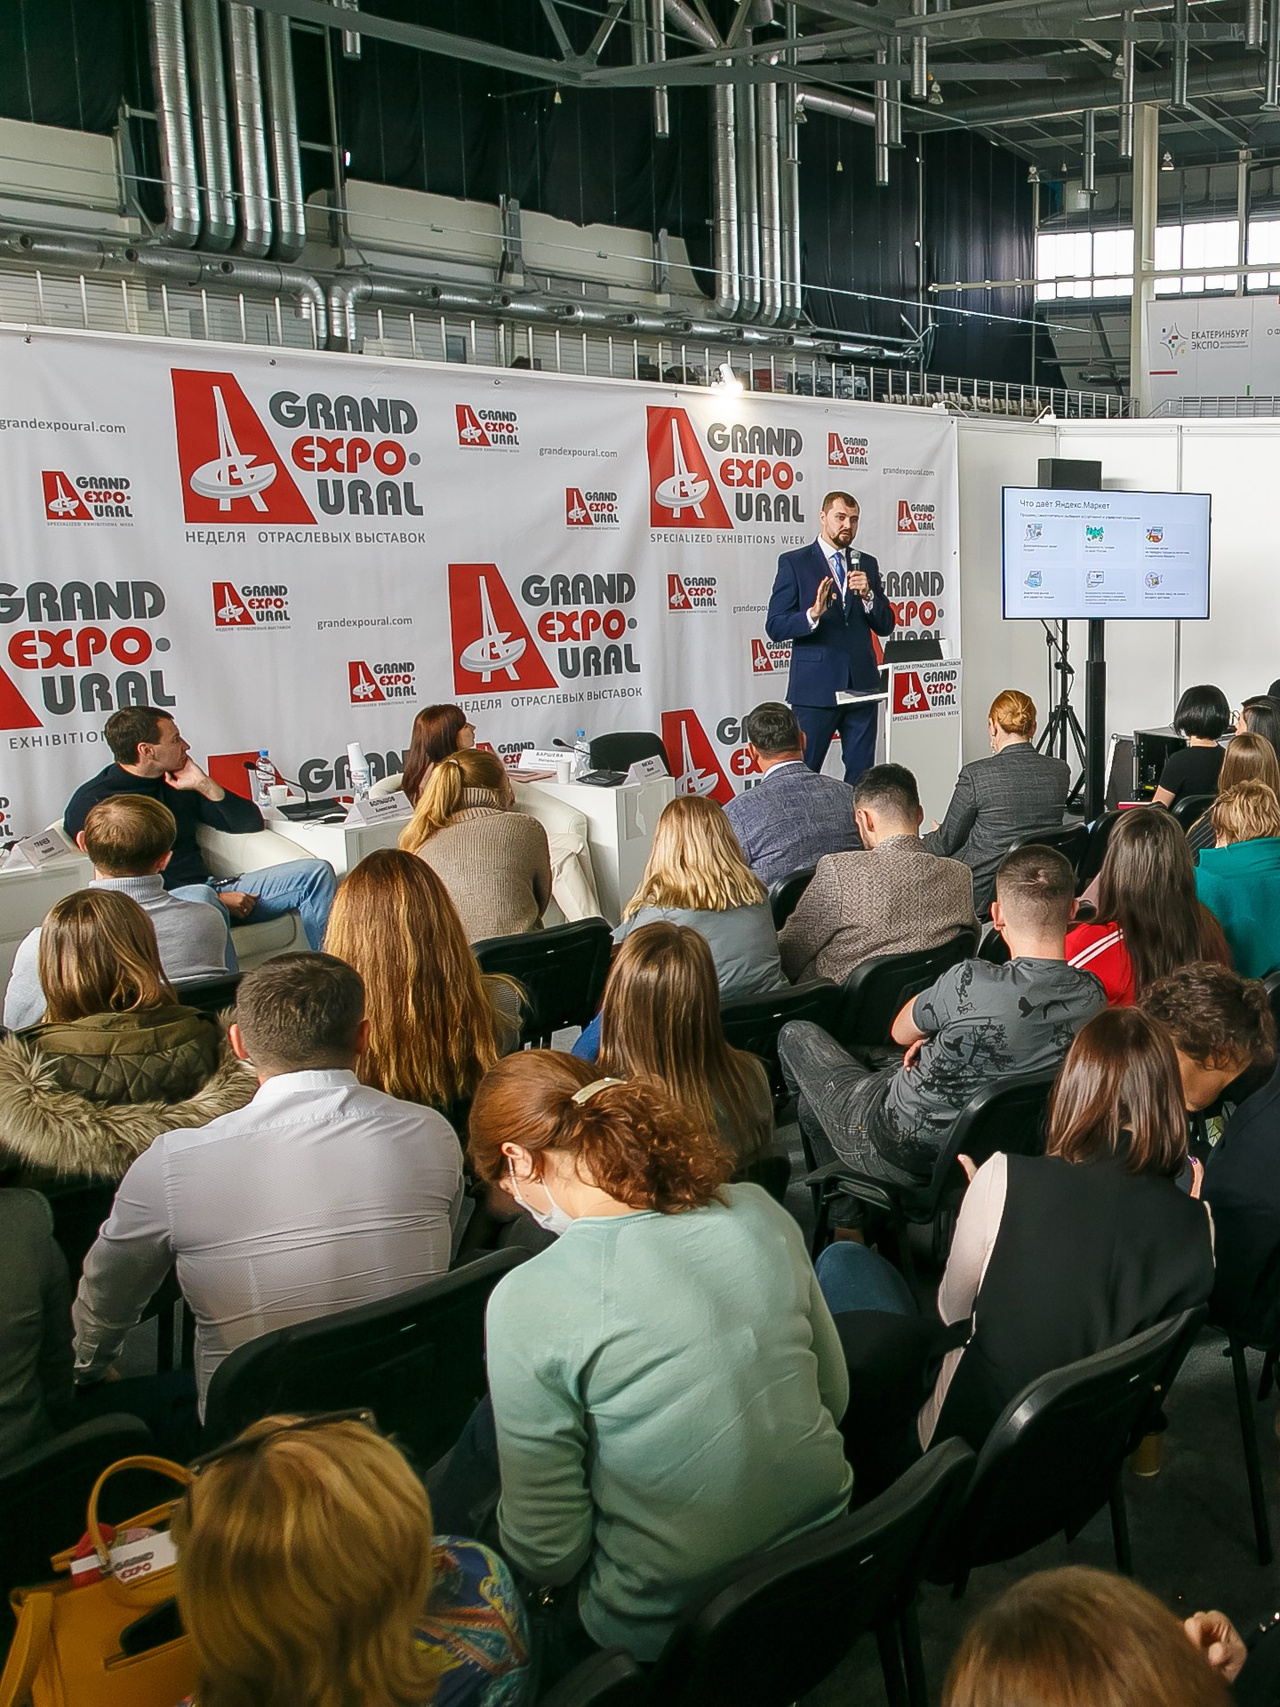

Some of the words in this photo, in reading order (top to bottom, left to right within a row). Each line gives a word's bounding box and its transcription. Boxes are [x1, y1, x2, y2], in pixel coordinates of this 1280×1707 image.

[1191, 329, 1249, 339] ЕКАТЕРИНБУРГ
[1191, 341, 1219, 350] ЭКСПО
[269, 391, 418, 434] GRAND
[479, 410, 517, 422] GRAND
[0, 418, 126, 433] grandexpoural.com
[492, 434, 519, 445] URAL
[707, 423, 803, 457] GRAND
[539, 446, 618, 458] grandexpoural.com
[76, 476, 130, 490] GRAND
[317, 479, 424, 516] URAL
[585, 492, 617, 501] GRAND
[735, 493, 805, 523] URAL
[1020, 500, 1034, 508] Что
[94, 505, 133, 517] URAL
[594, 514, 619, 523] URAL
[186, 531, 246, 545] НЕДЕЛЯ
[258, 531, 351, 544] ОТРАСЛЕВЫХ
[355, 532, 426, 544] ВЫСТАВОК
[650, 534, 712, 543] SPECIALIZED
[716, 535, 775, 544] EXHIBITIONS
[781, 536, 805, 544] WEEK
[684, 577, 716, 586] GRAND
[880, 571, 944, 598] RAND
[242, 585, 288, 596] GRAND
[522, 573, 636, 606] GRAND
[256, 610, 290, 621] URAL
[318, 617, 413, 630] grandexpoural.com
[558, 644, 641, 679] URAL
[774, 660, 789, 668] URA
[373, 662, 415, 674] GRAND
[923, 670, 957, 682] GRAND
[42, 671, 176, 715] URAL
[386, 686, 416, 697] URAL
[511, 692, 584, 707] ОТРАСЛЕВЫХ
[587, 687, 643, 700] ВЫСТАВОК
[931, 694, 956, 706] URAL
[9, 731, 106, 749] EXHIBITIO
